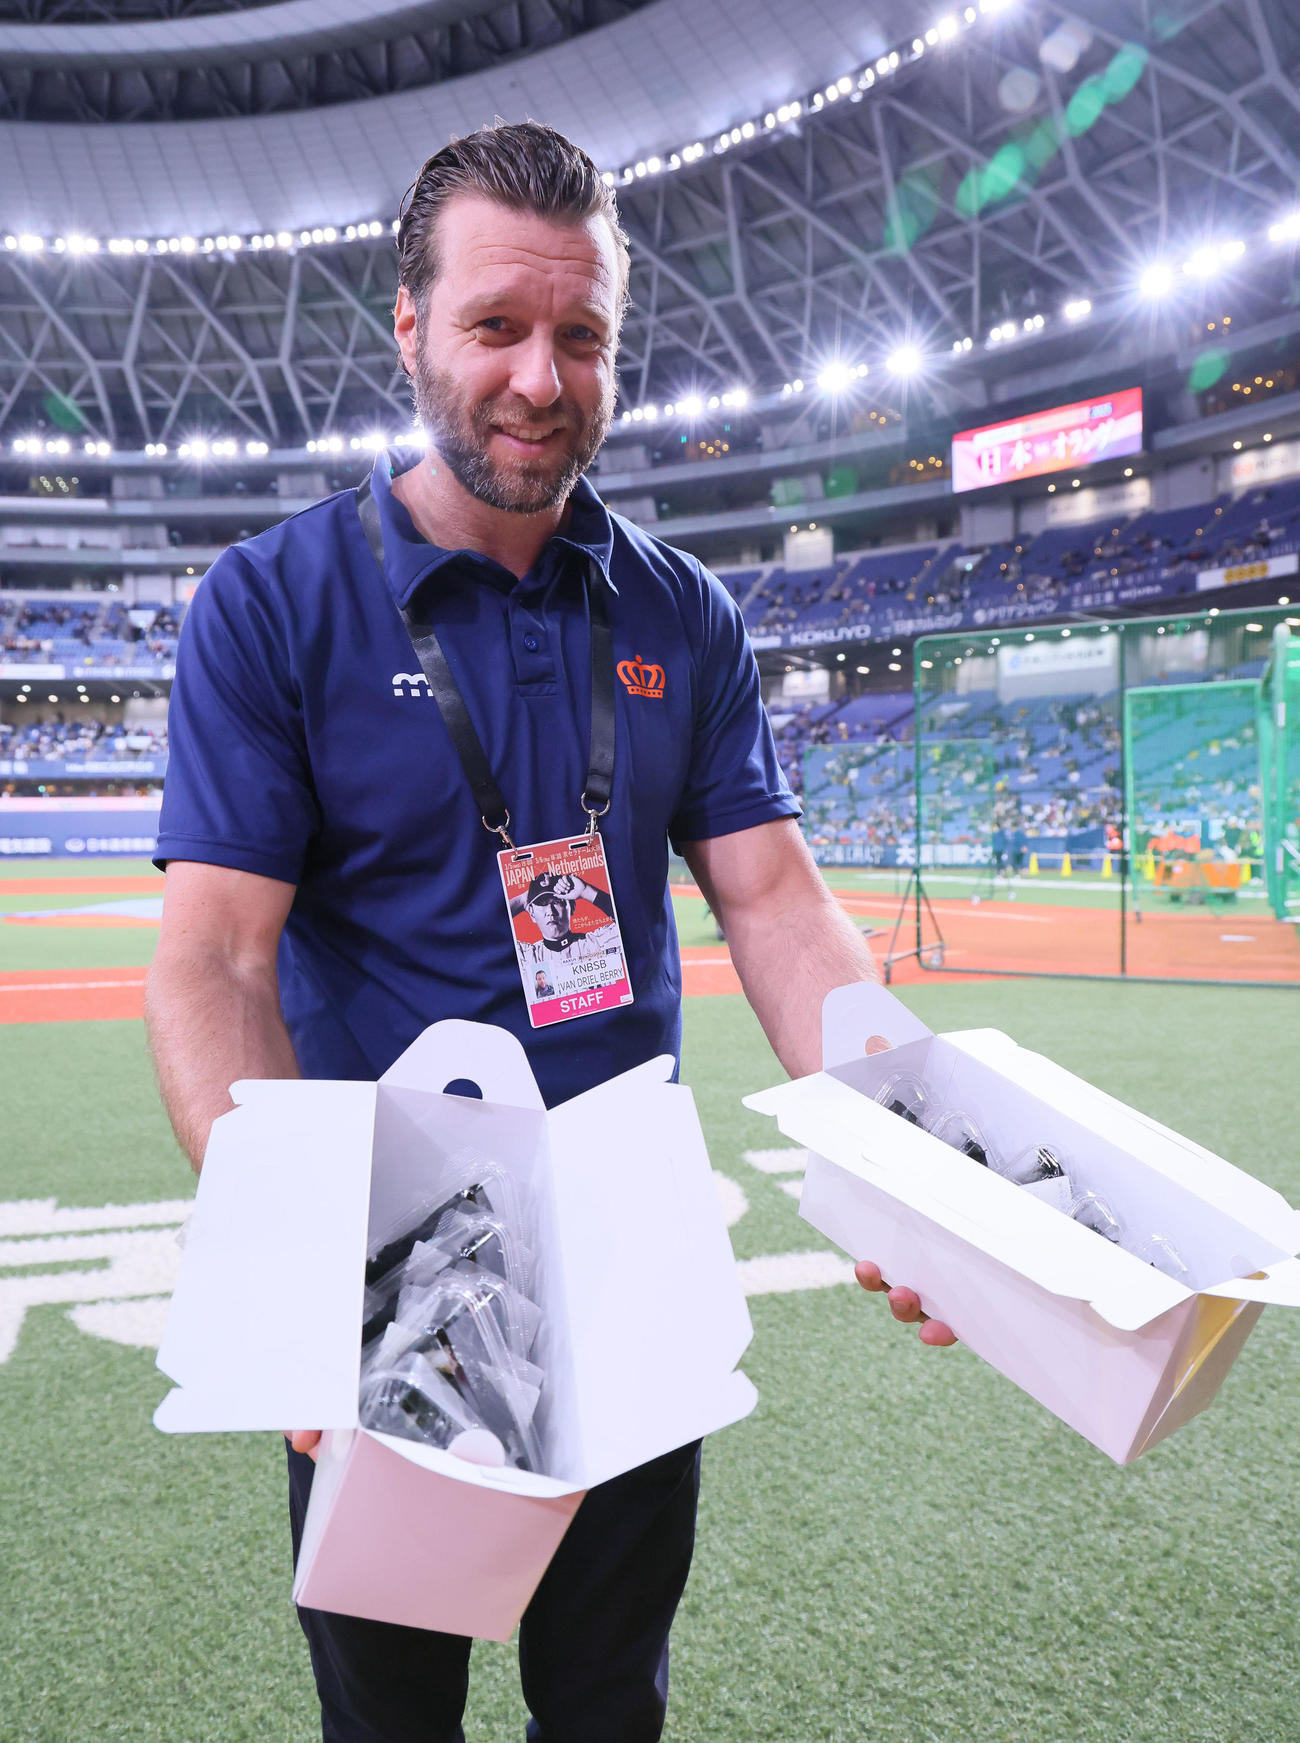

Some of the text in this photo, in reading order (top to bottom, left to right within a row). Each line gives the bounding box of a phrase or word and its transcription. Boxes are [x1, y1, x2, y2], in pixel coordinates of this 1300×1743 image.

[790, 624, 871, 645] KOKUYO
[504, 866, 535, 887] JAPAN
[547, 852, 604, 878] Netherlands
[572, 959, 607, 975] KNBSB
[560, 968, 623, 992] VAN DRIEL BERRY
[560, 991, 604, 1013] STAFF
